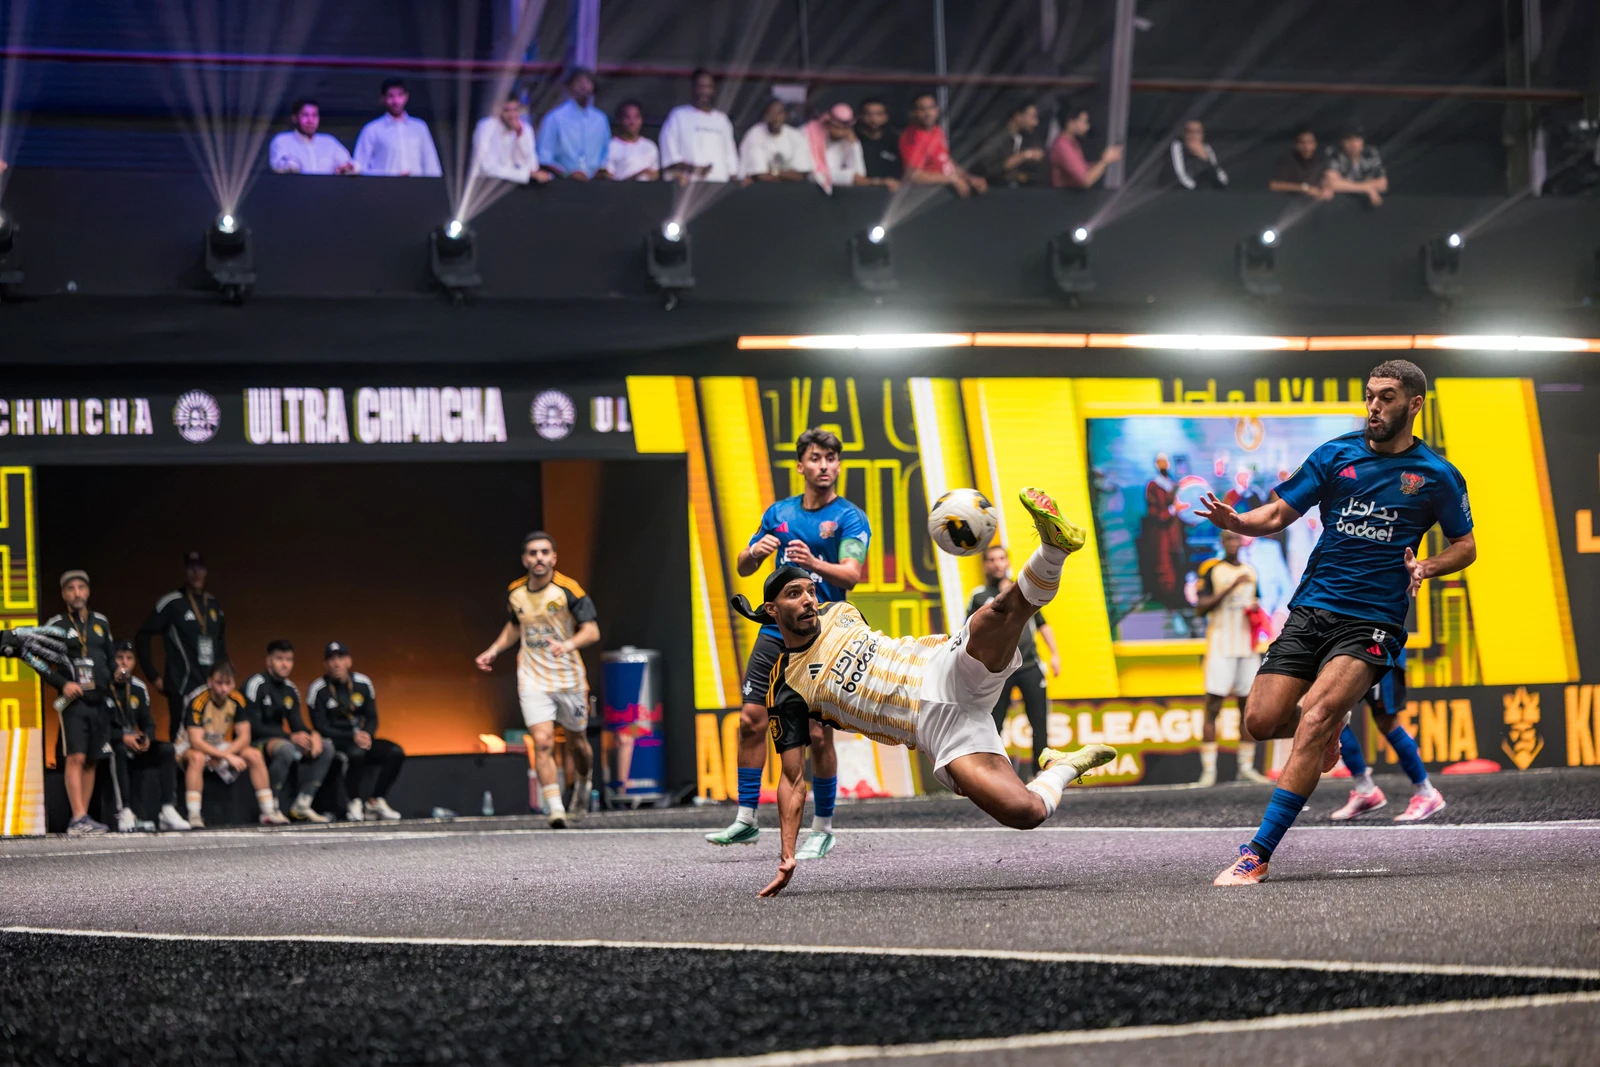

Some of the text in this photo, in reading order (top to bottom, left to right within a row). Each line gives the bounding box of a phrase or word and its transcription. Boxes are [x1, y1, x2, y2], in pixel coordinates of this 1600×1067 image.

[244, 386, 508, 444] ULTRA CHMICHA
[1336, 517, 1394, 543] badael
